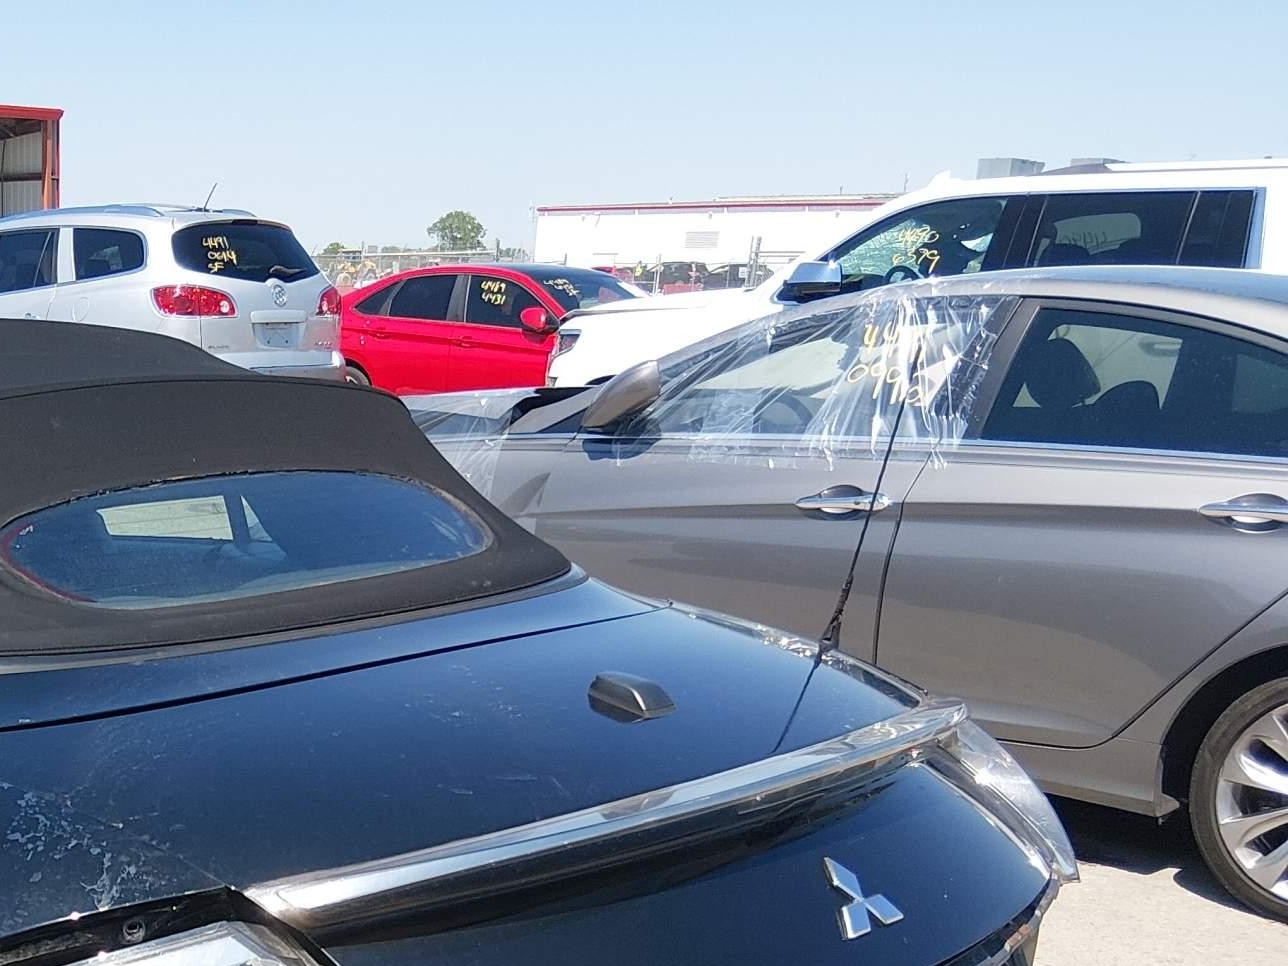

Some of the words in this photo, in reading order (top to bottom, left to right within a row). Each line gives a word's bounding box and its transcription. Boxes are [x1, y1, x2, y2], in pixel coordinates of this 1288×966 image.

[202, 235, 229, 249] 4491
[207, 250, 238, 266] 0614
[892, 247, 941, 275] 6379
[481, 291, 507, 305] 4431
